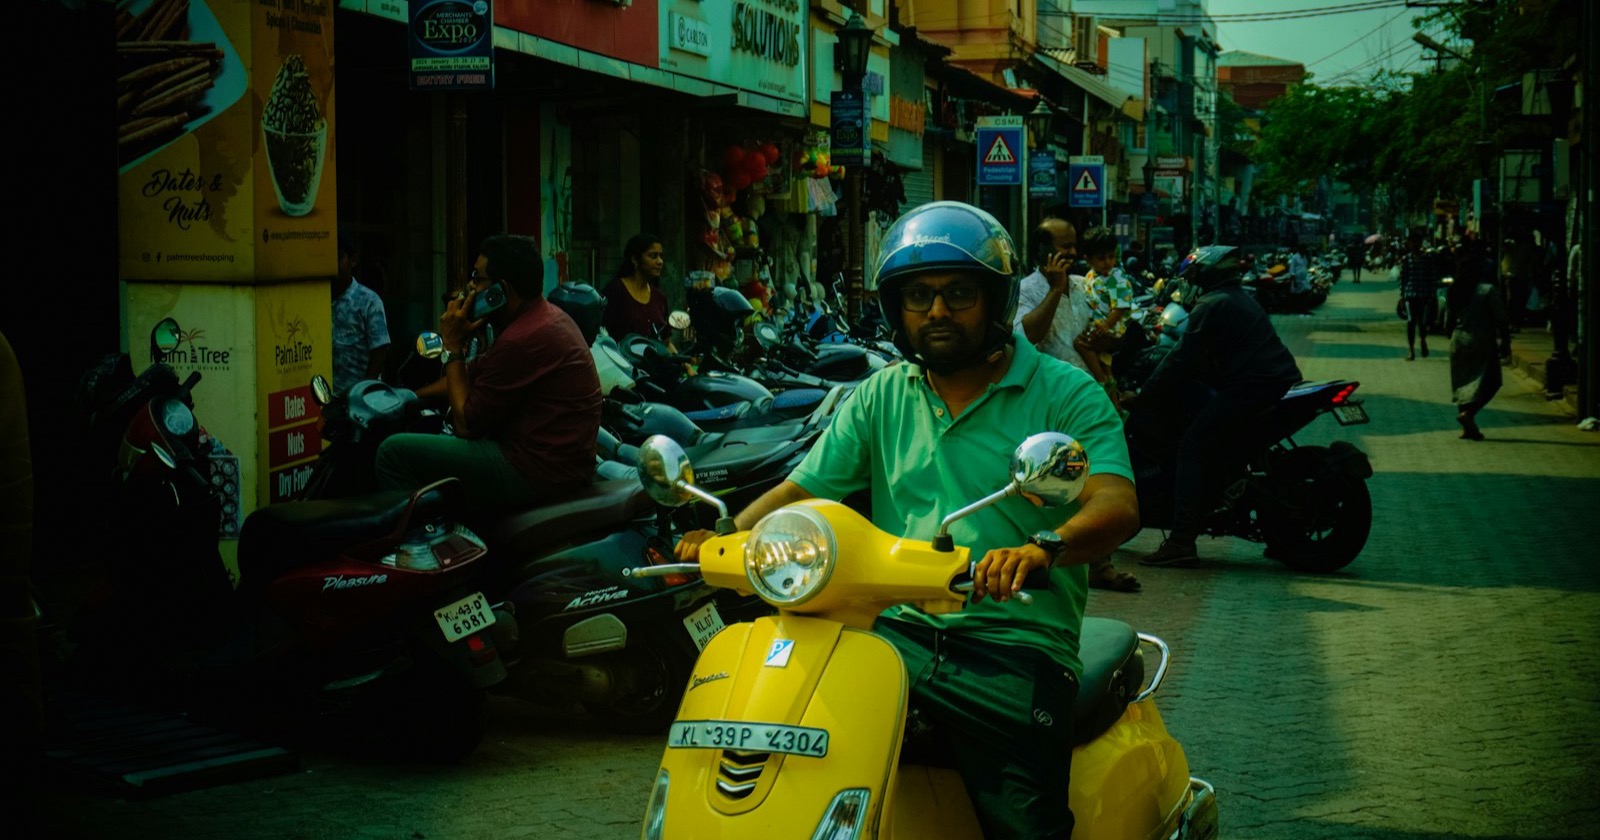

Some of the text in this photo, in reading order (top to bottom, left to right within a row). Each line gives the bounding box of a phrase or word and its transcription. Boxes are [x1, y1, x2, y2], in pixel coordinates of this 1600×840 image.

[424, 20, 477, 43] Expo
[686, 27, 708, 46] CARLTON
[731, 2, 799, 67] SOLUTIONS
[416, 74, 486, 86] ENTRY FREE
[994, 118, 1021, 126] CSML
[983, 166, 1016, 174] Pedestrian
[986, 174, 1013, 182] Crossing
[142, 168, 222, 197] Dates &
[163, 197, 211, 231] Nuts
[166, 252, 234, 262] palmtreeshopping
[198, 347, 230, 363] Tree
[275, 341, 312, 366] Palm Tree
[284, 395, 305, 420] Dates
[287, 431, 305, 457] Nuts
[278, 472, 292, 498] Dry
[321, 574, 388, 593] Pleasure
[562, 589, 629, 612] Activa
[453, 611, 487, 635] 6081
[681, 726, 698, 745] KL
[768, 729, 825, 754] 4304
